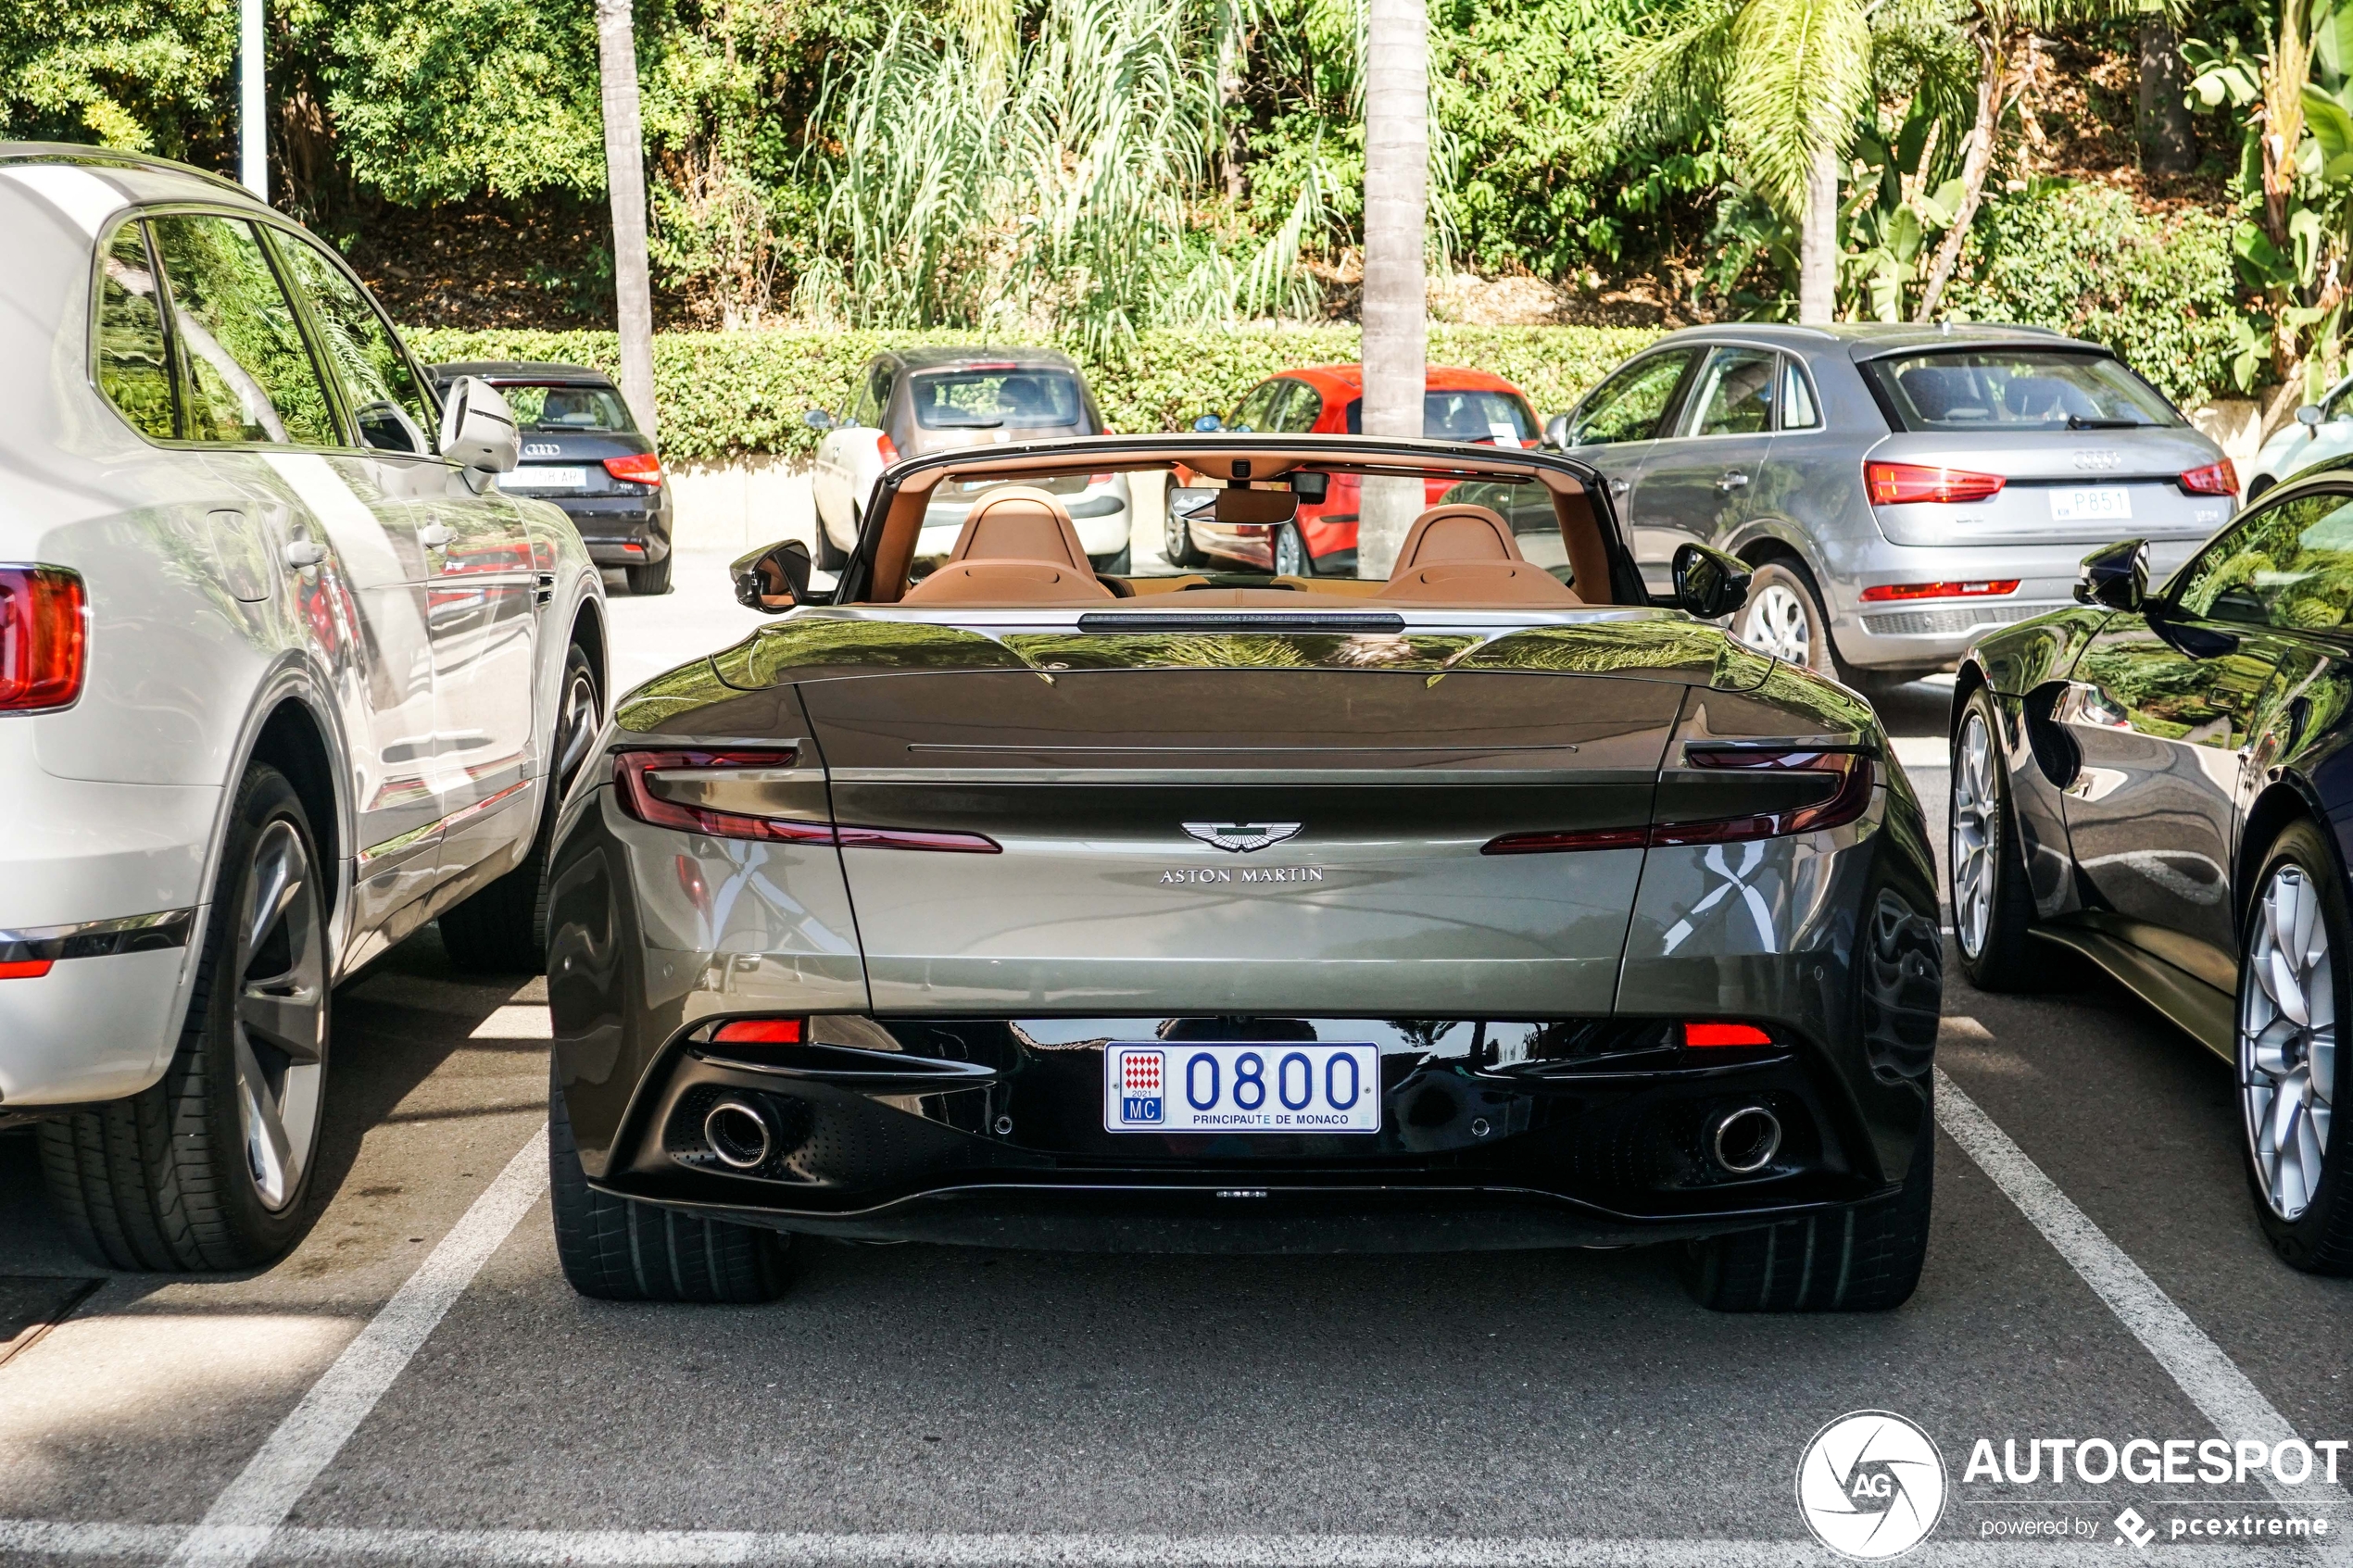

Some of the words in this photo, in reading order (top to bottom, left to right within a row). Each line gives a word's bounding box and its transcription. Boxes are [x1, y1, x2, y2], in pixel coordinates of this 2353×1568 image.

[560, 470, 577, 483] AR
[2074, 492, 2123, 511] P851
[1160, 869, 1232, 884] ASTON
[1241, 867, 1324, 883] MARTIN
[1186, 1051, 1360, 1111] 0800
[1130, 1100, 1155, 1119] MC
[1193, 1114, 1271, 1124] PRINCIPAUTE
[1276, 1114, 1291, 1124] DE
[1296, 1114, 1349, 1124] MONACO
